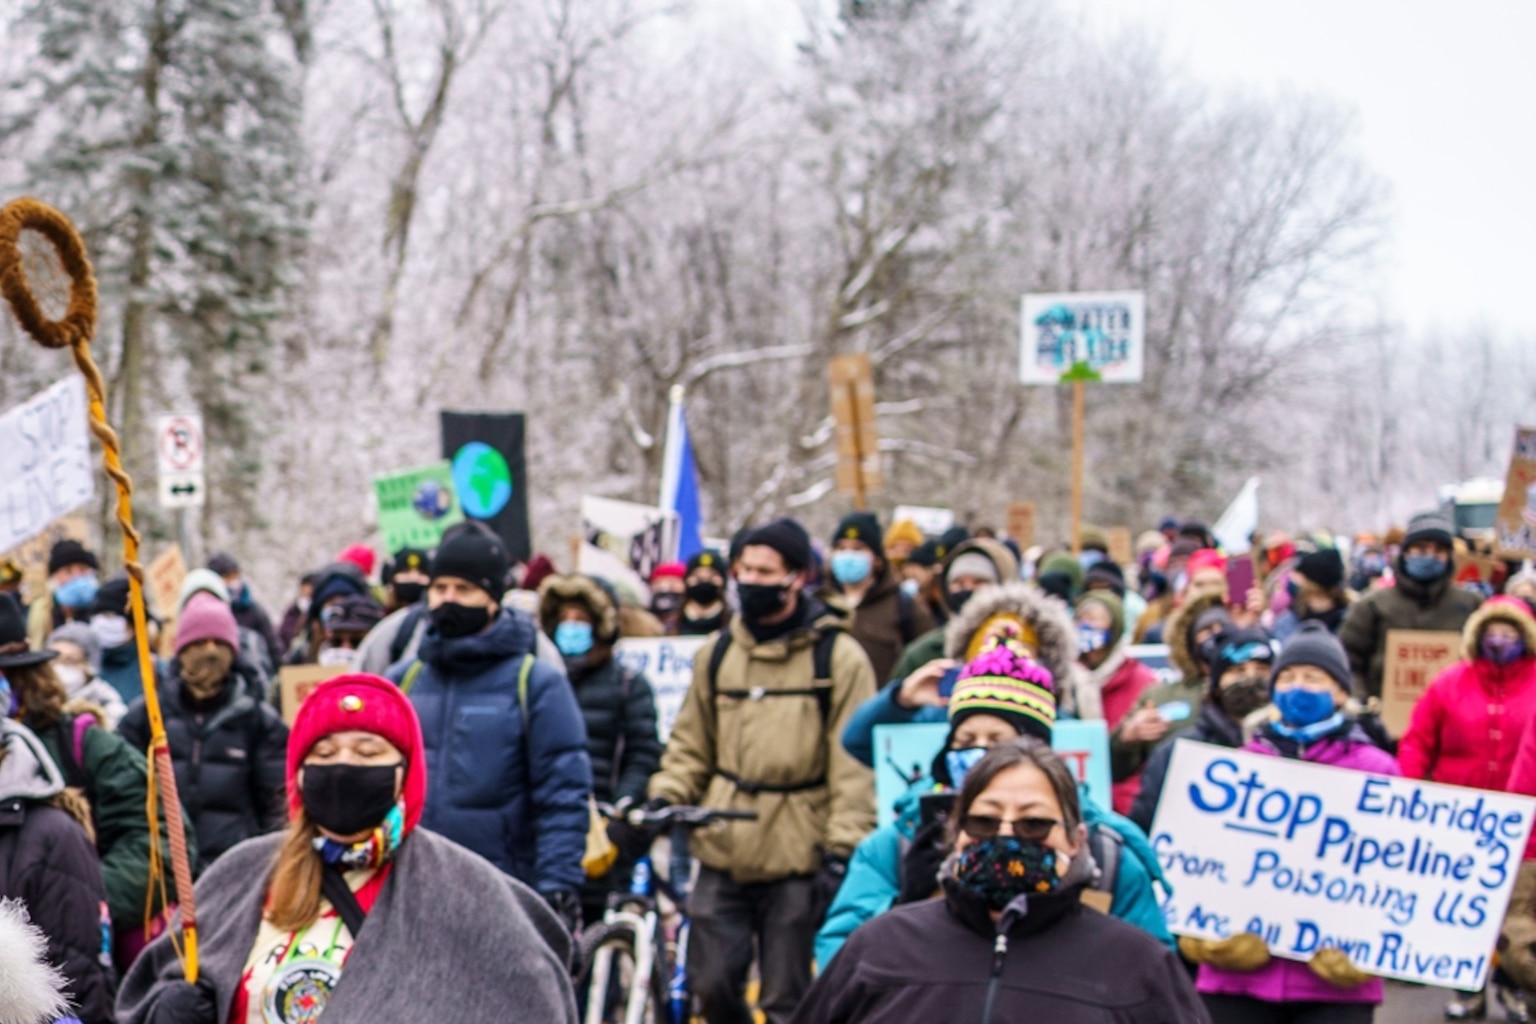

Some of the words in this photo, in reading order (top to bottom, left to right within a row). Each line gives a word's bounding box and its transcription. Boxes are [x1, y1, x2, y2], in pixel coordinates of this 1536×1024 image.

[1356, 778, 1524, 848] Enbridge
[1244, 849, 1418, 926] Poisoning
[1316, 816, 1475, 883] Pipeline
[1477, 837, 1511, 890] 3
[1185, 904, 1231, 939] Are
[1245, 915, 1282, 945] All
[1292, 919, 1371, 964] Down
[1375, 930, 1485, 981] River!
